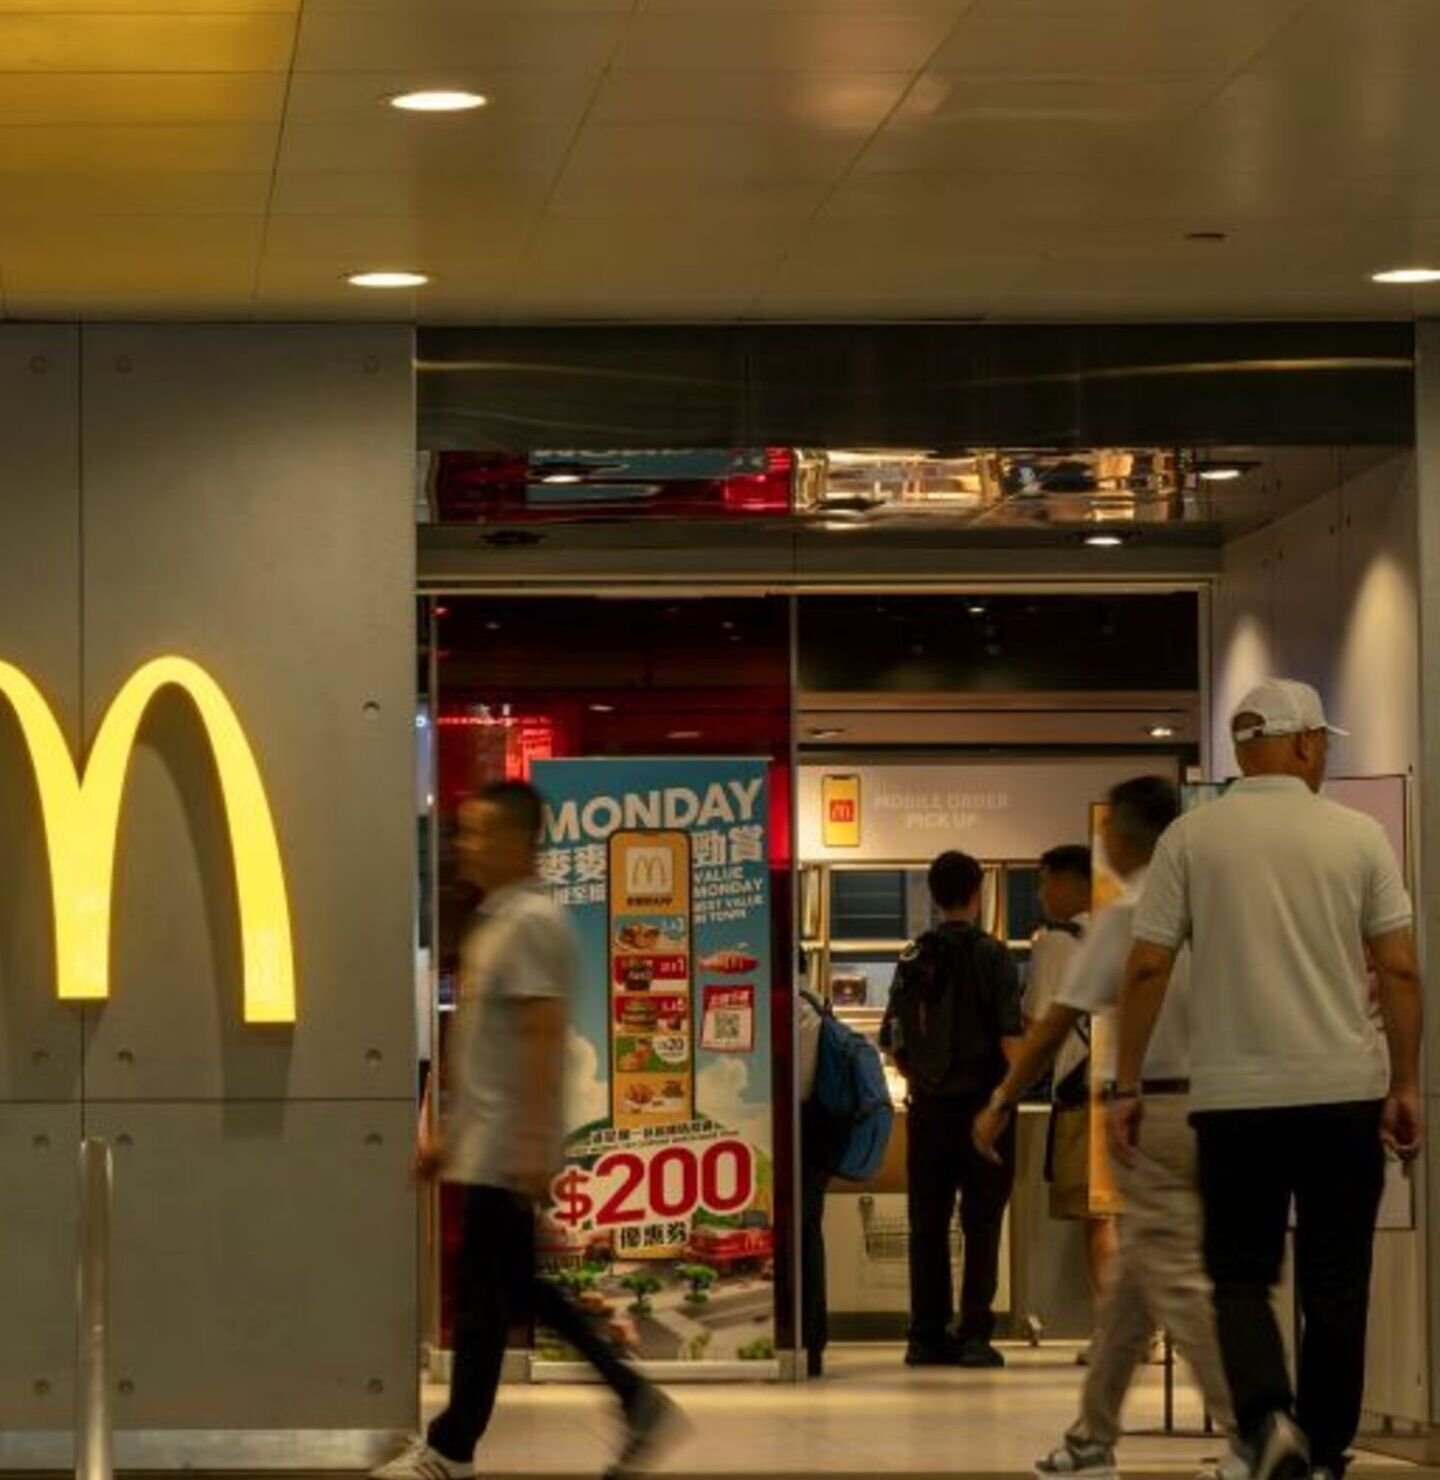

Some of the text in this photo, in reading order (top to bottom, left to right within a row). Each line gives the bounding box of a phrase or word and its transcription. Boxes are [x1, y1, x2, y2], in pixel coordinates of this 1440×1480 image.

[874, 792, 1009, 809] MOBILE ORDER
[539, 780, 763, 844] MONDAY
[907, 812, 979, 830] PICK UP
[693, 866, 744, 884] VALUE
[693, 878, 764, 898] MONDAY
[723, 893, 765, 911] VALUE
[711, 909, 747, 922] TOWN
[552, 1140, 754, 1228] $200
